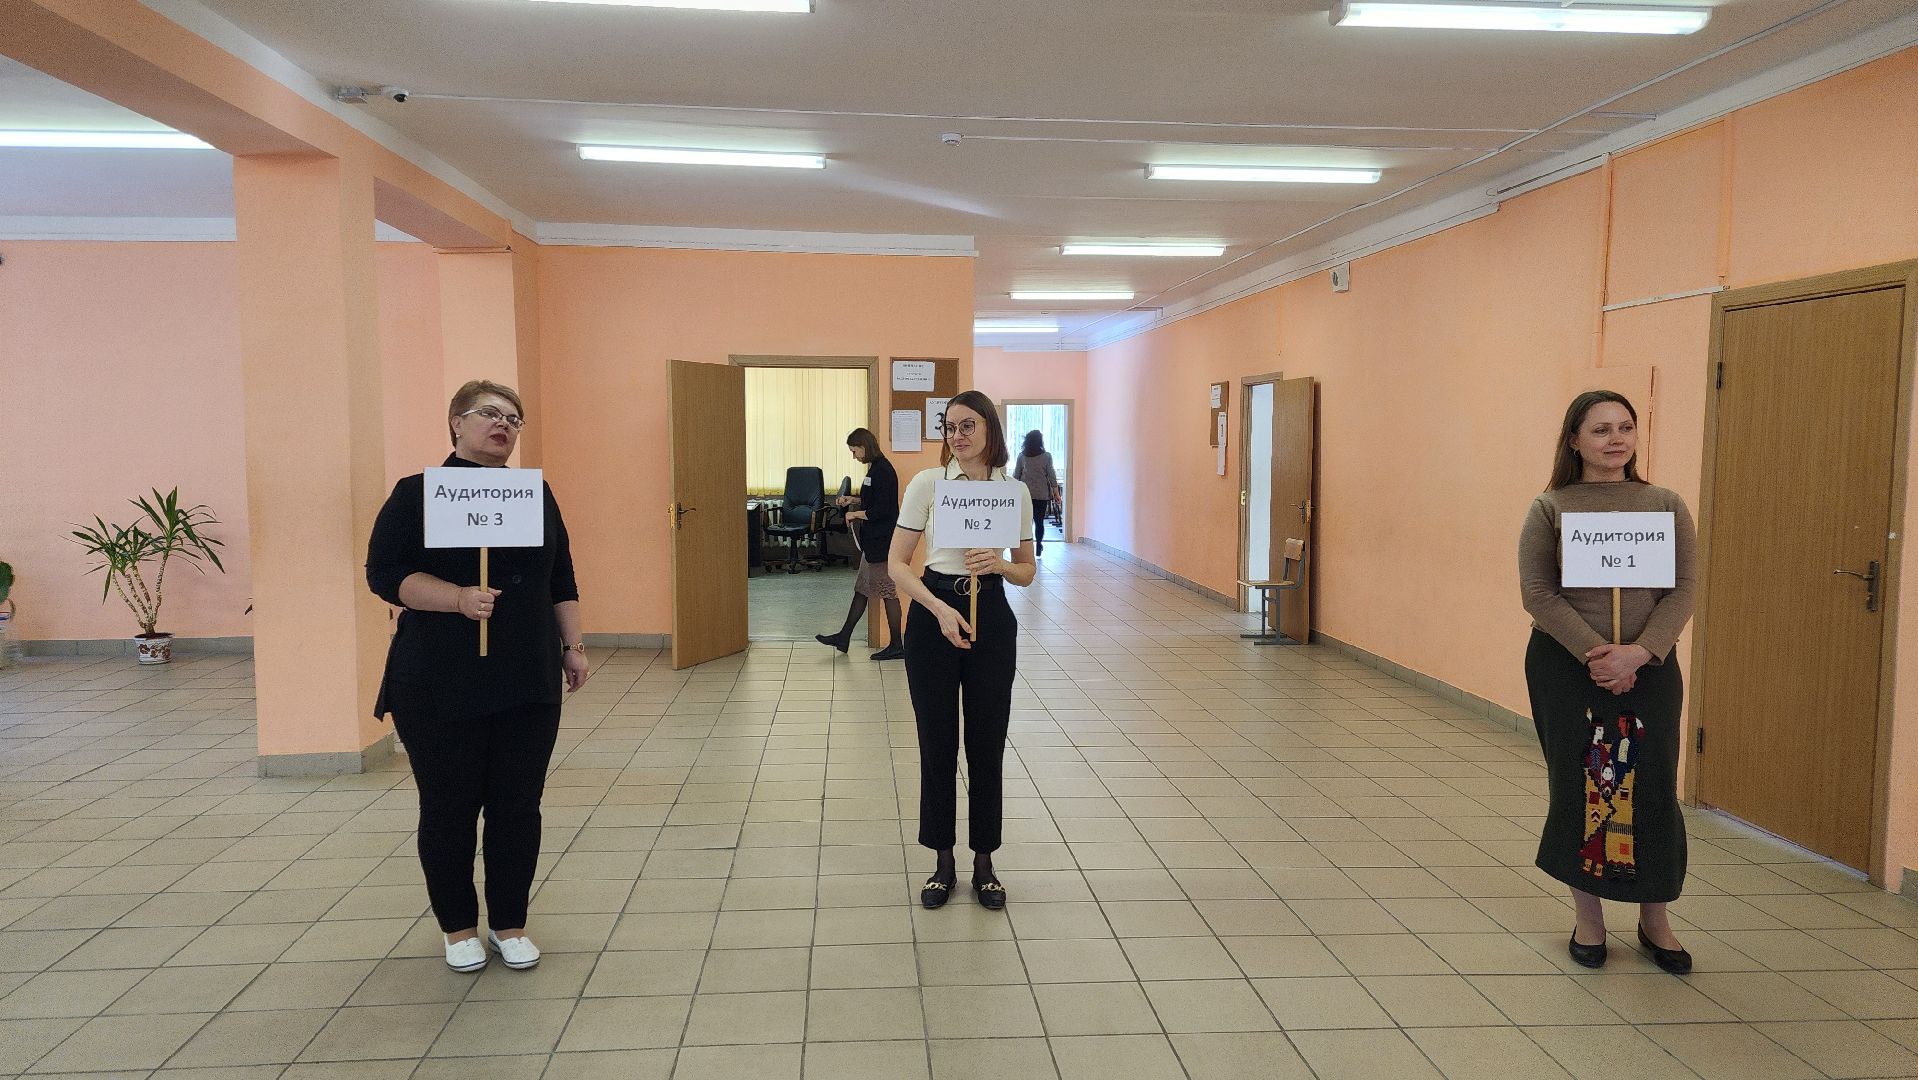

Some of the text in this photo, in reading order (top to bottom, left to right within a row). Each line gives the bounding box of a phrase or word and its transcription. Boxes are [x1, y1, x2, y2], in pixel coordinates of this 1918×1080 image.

[434, 485, 534, 502] Аудитория
[941, 495, 1015, 510] Аудитория
[467, 512, 503, 526] № 3
[964, 519, 992, 530] № 2
[1570, 529, 1665, 545] Аудитория
[1601, 555, 1637, 568] № 1
